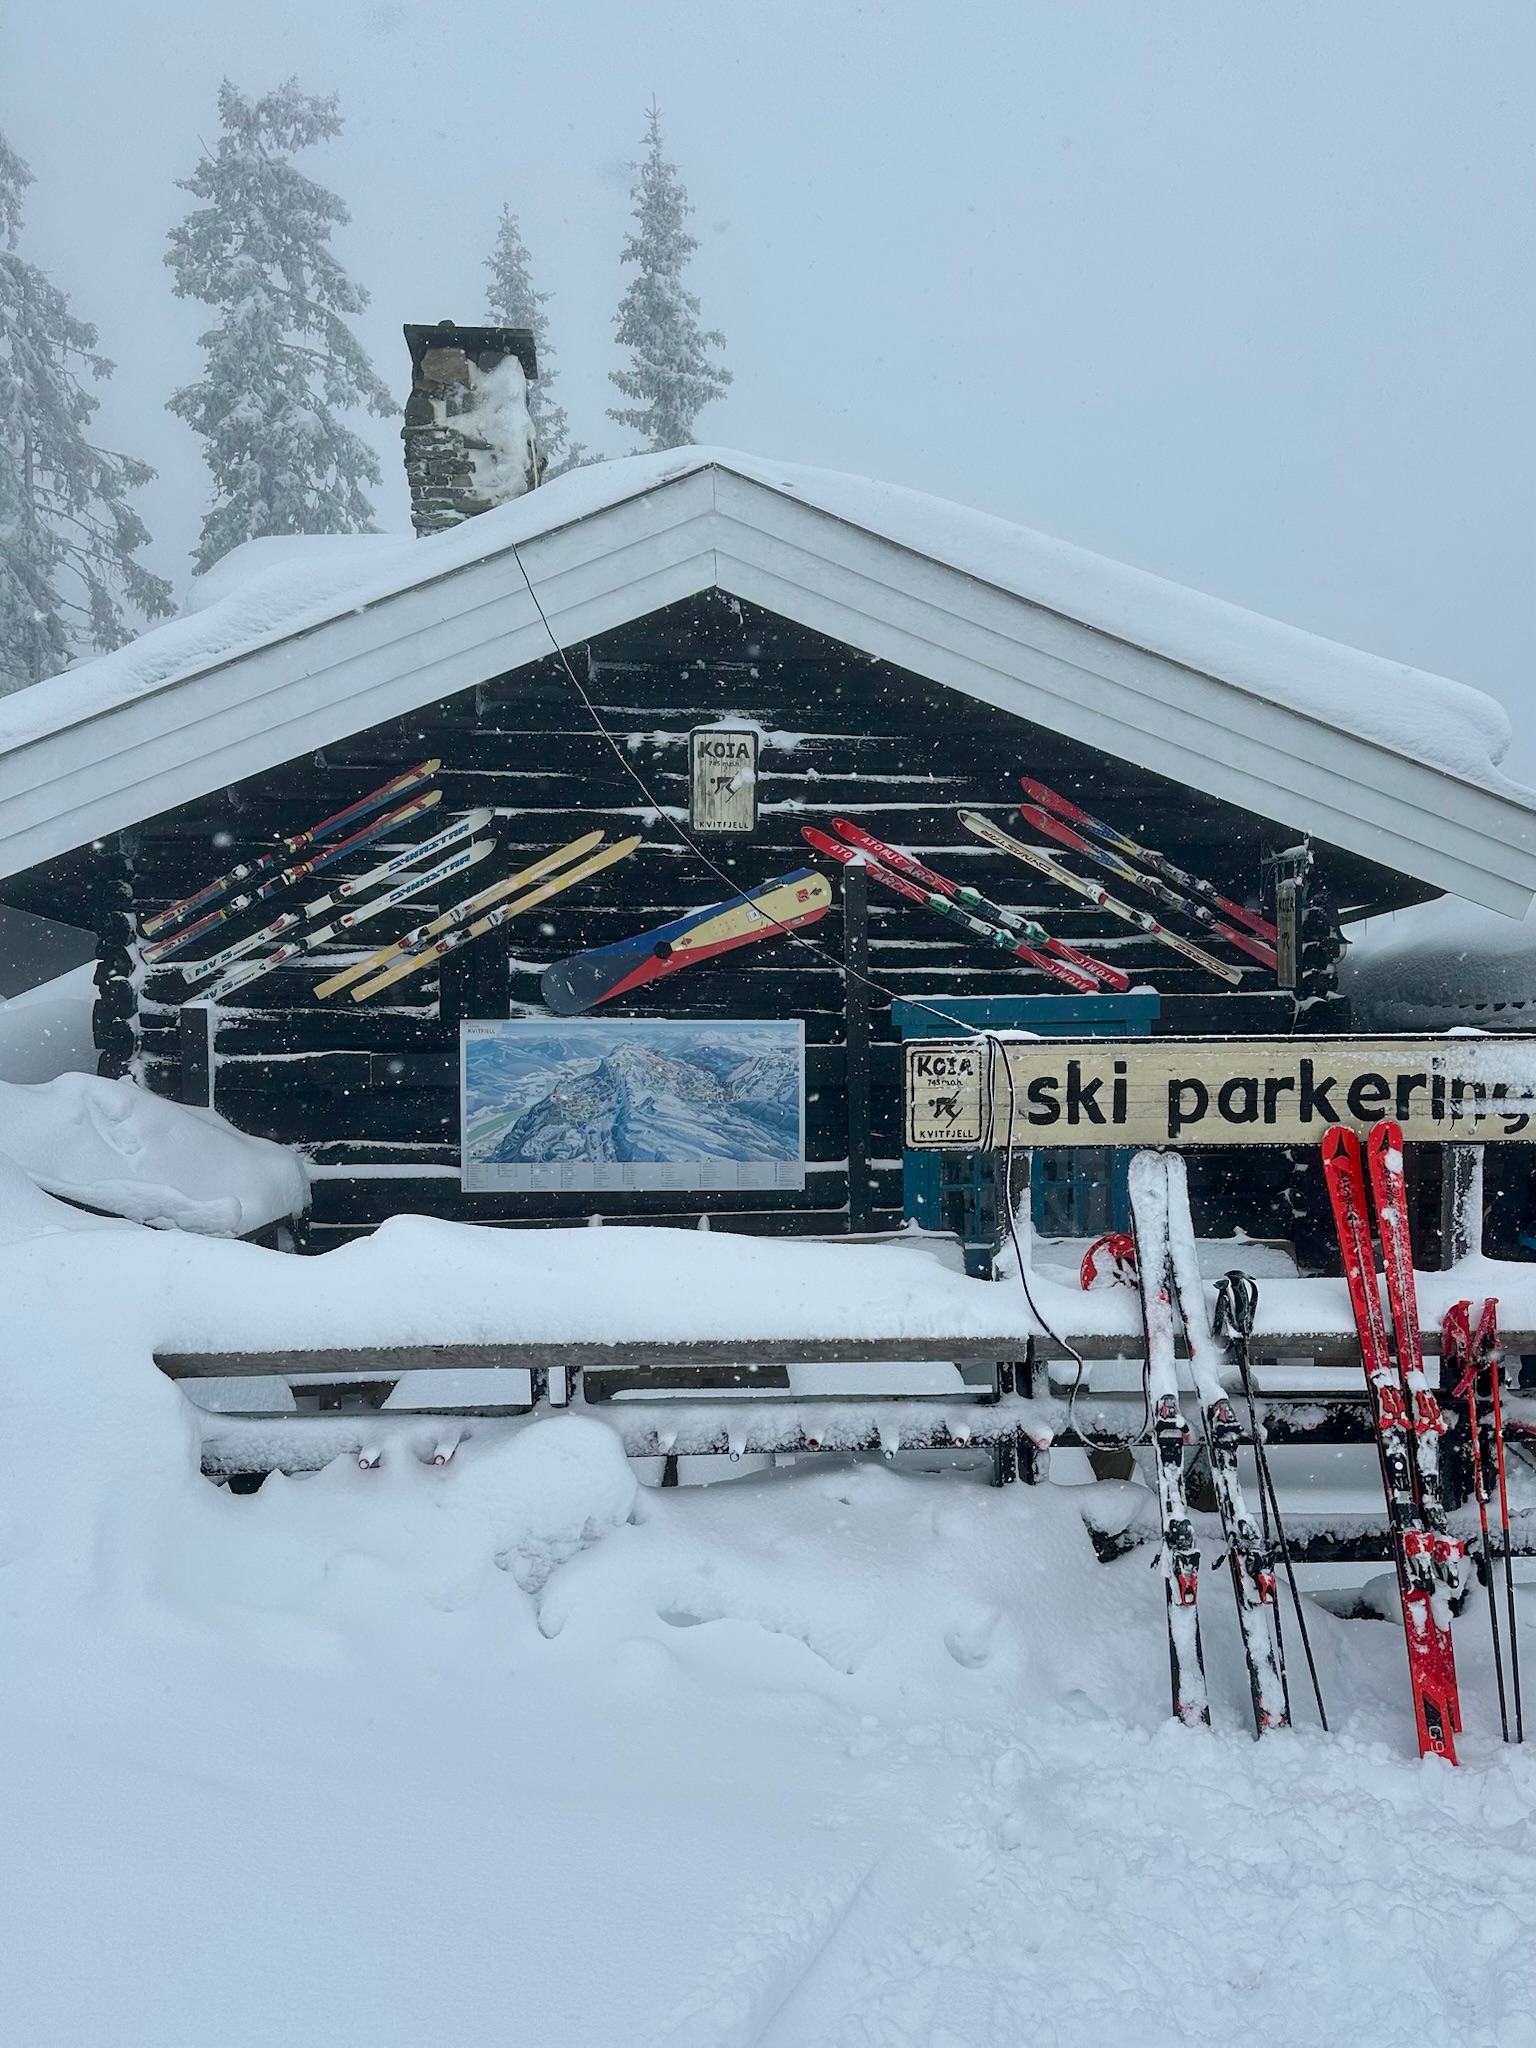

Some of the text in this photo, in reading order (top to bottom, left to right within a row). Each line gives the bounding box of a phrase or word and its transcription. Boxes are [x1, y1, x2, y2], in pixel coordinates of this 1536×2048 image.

[697, 741, 750, 759] KOIA
[699, 821, 749, 829] KVITFJELL
[388, 823, 470, 872] DYNASTAR
[861, 837, 902, 864] ATOMIC
[980, 829, 1052, 873] DYNASTAR
[390, 854, 471, 903] DYNASTAR
[1047, 964, 1090, 989] ATOMIC
[1077, 958, 1119, 983] ATOMIC
[917, 1055, 974, 1077] KOIA
[927, 1079, 941, 1087] 745
[1027, 1060, 1127, 1125] ski
[919, 1129, 974, 1139] KVITFJELL
